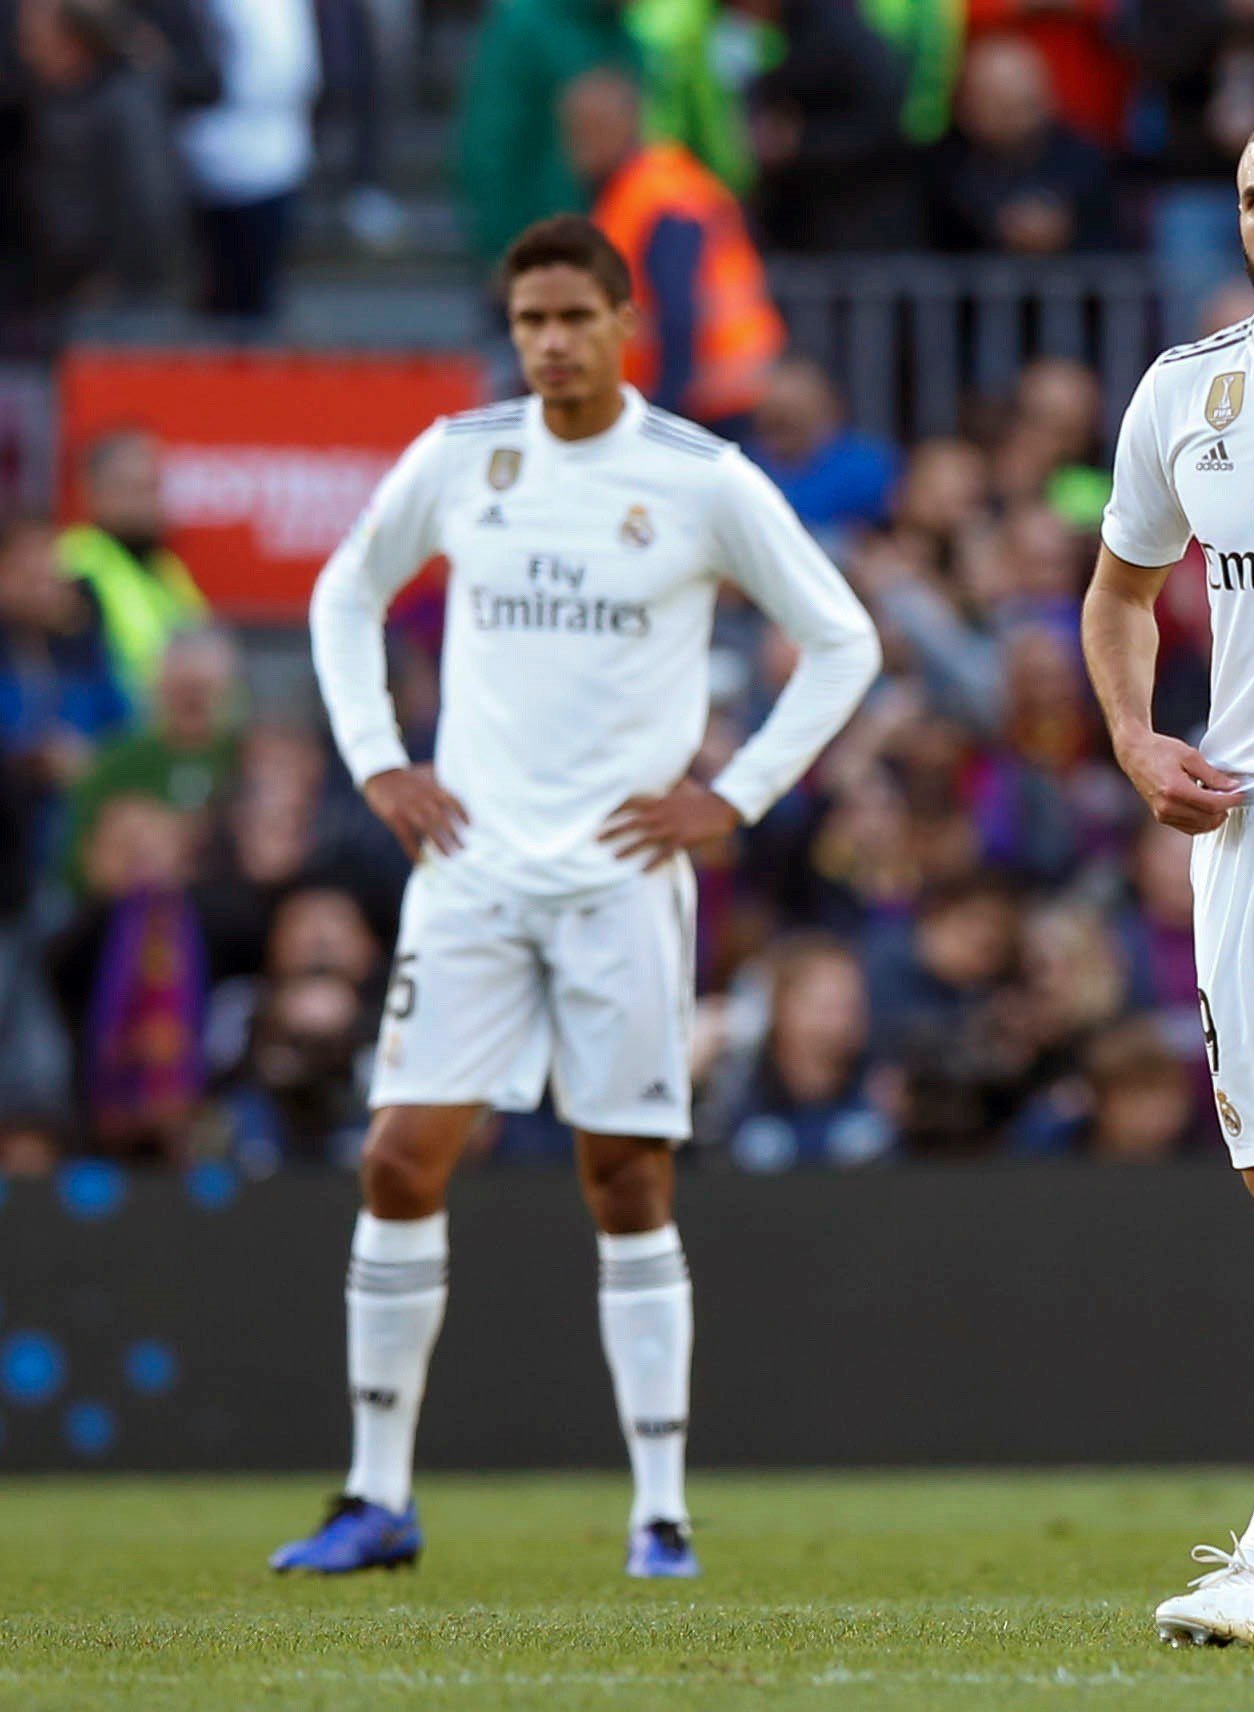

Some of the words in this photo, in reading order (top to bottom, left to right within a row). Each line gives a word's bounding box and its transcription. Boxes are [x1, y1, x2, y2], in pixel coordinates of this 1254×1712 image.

[1195, 460, 1234, 471] adidas
[529, 555, 586, 589] Fly
[471, 586, 652, 637] Emirates
